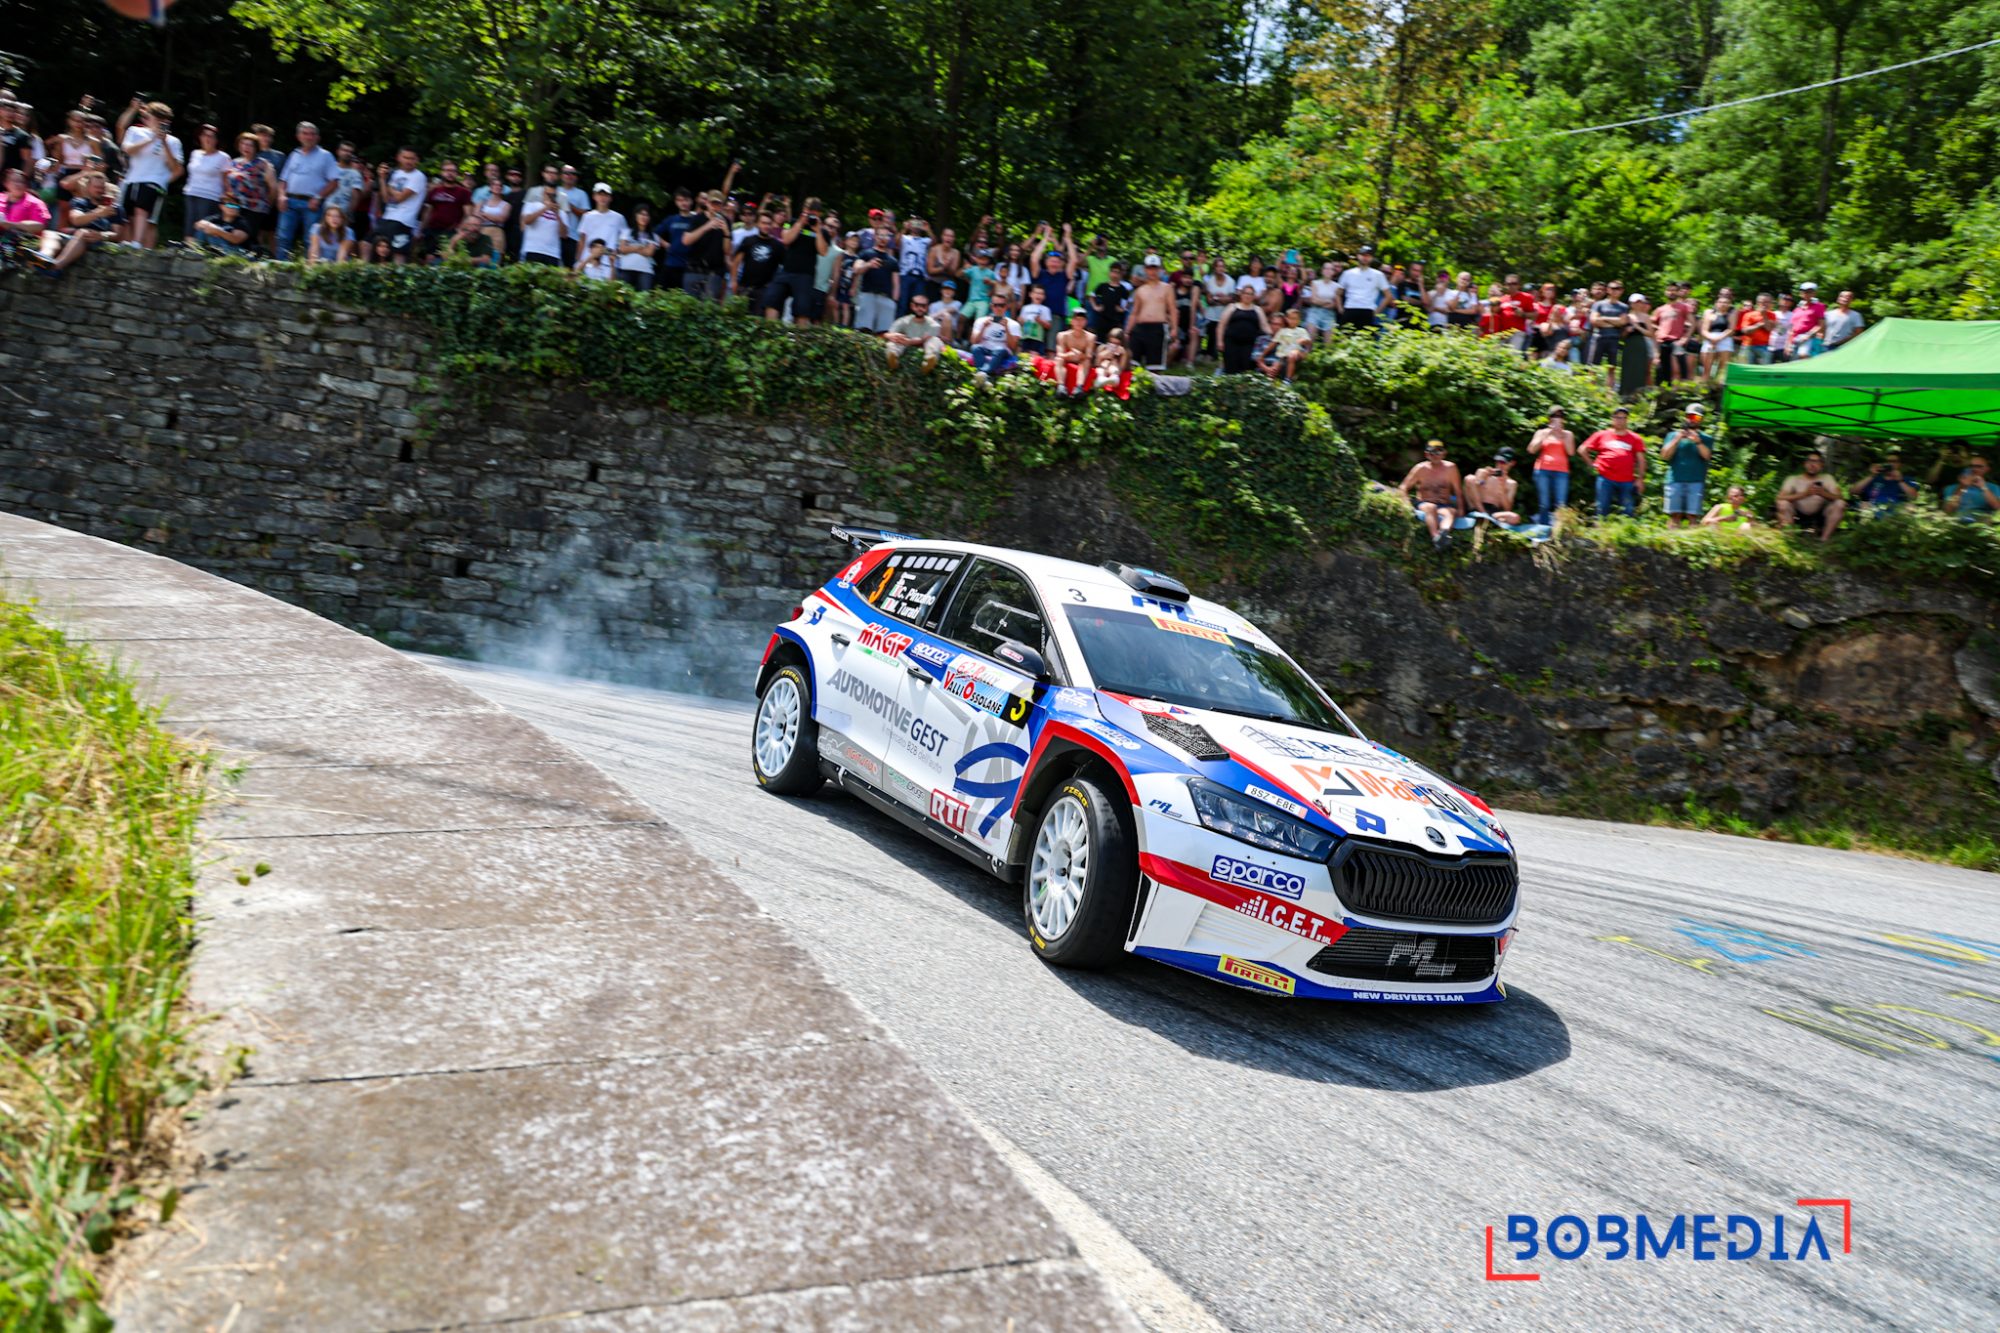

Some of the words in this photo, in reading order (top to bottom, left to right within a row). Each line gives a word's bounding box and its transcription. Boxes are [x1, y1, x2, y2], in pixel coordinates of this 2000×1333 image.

[868, 566, 895, 604] 3
[1068, 588, 1087, 603] 3
[1156, 617, 1228, 644] PIRELLI
[911, 642, 950, 662] sparco
[826, 667, 913, 733] AUTOMOTIVE
[910, 718, 949, 757] GEST
[1010, 687, 1035, 722] 3
[931, 794, 969, 829] RTI
[1215, 858, 1303, 893] sparco
[1224, 957, 1289, 990] PIRELLI
[1353, 991, 1382, 1000] NEW
[1382, 992, 1433, 1002] DRIVER'S
[1433, 994, 1465, 1002] TEAM
